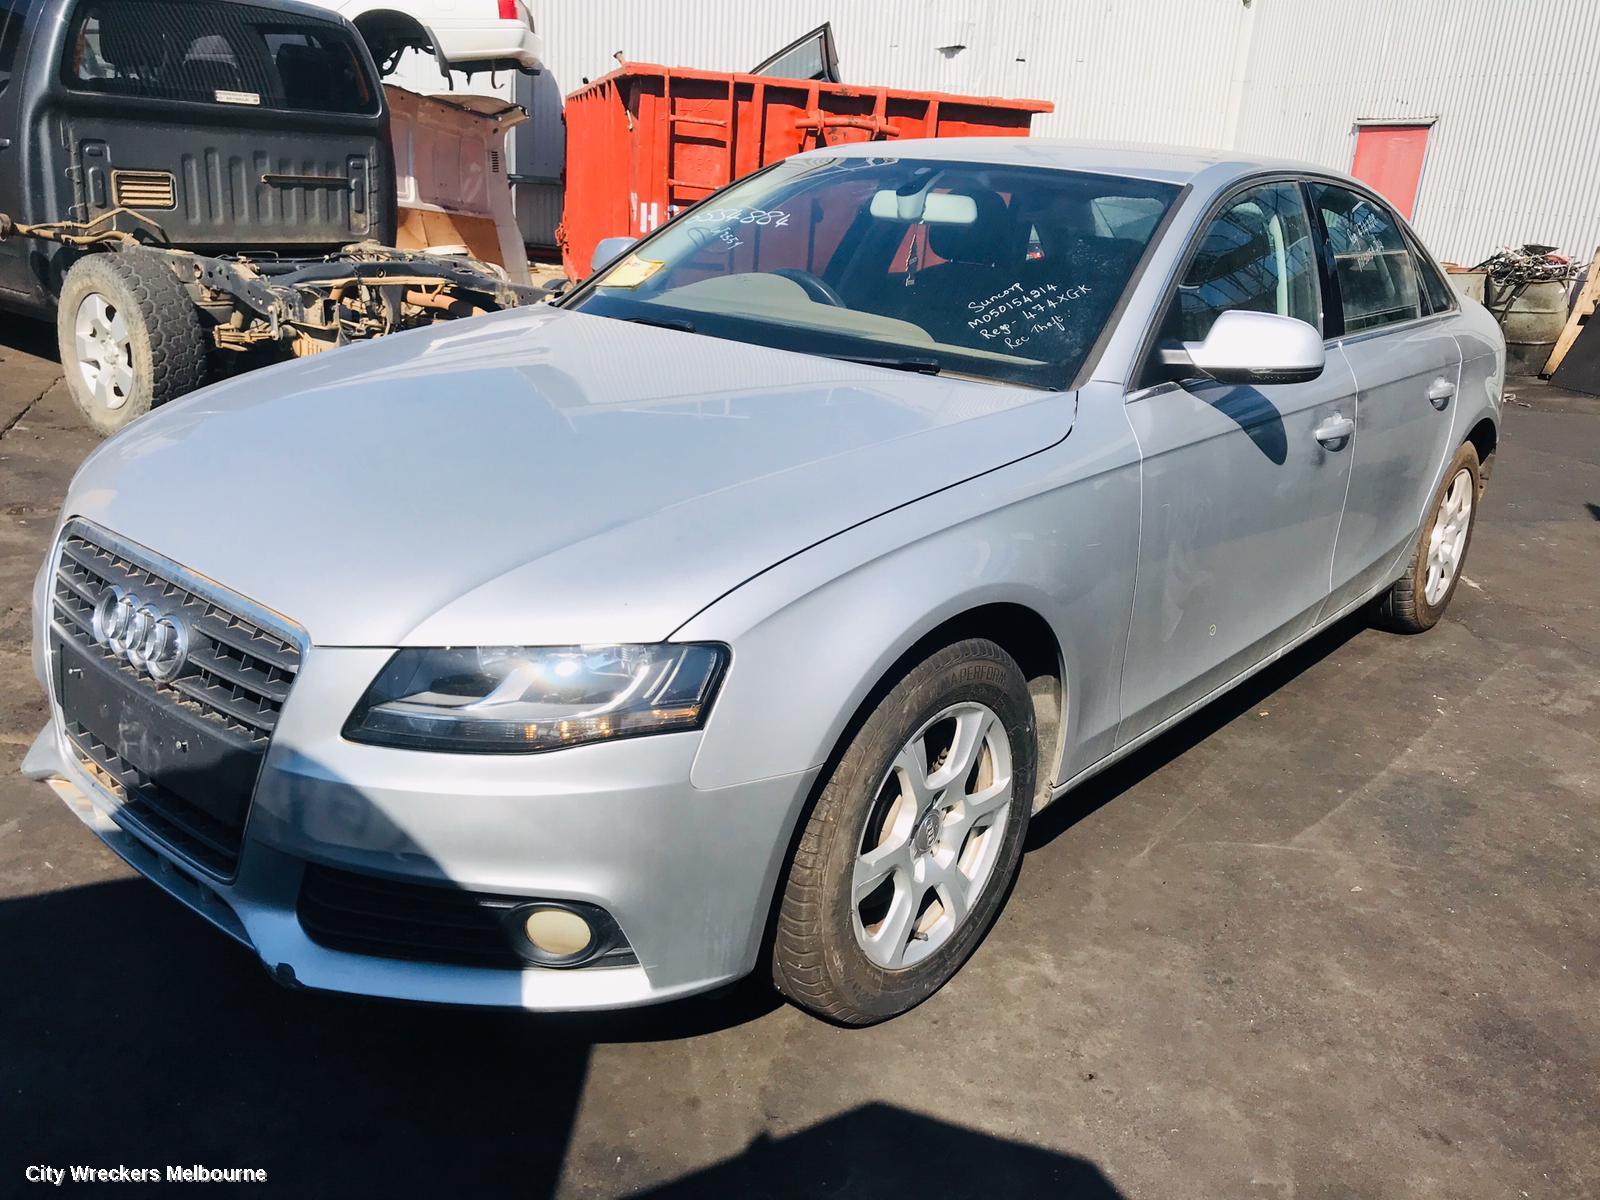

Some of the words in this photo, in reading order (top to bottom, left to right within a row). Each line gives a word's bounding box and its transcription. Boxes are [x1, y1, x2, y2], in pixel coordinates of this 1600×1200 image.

[967, 282, 1024, 313] Suncorp
[967, 283, 1058, 329] M050154914
[1022, 284, 1092, 320] 474XGK
[1004, 335, 1030, 350] Rec
[1030, 314, 1066, 333] Theft
